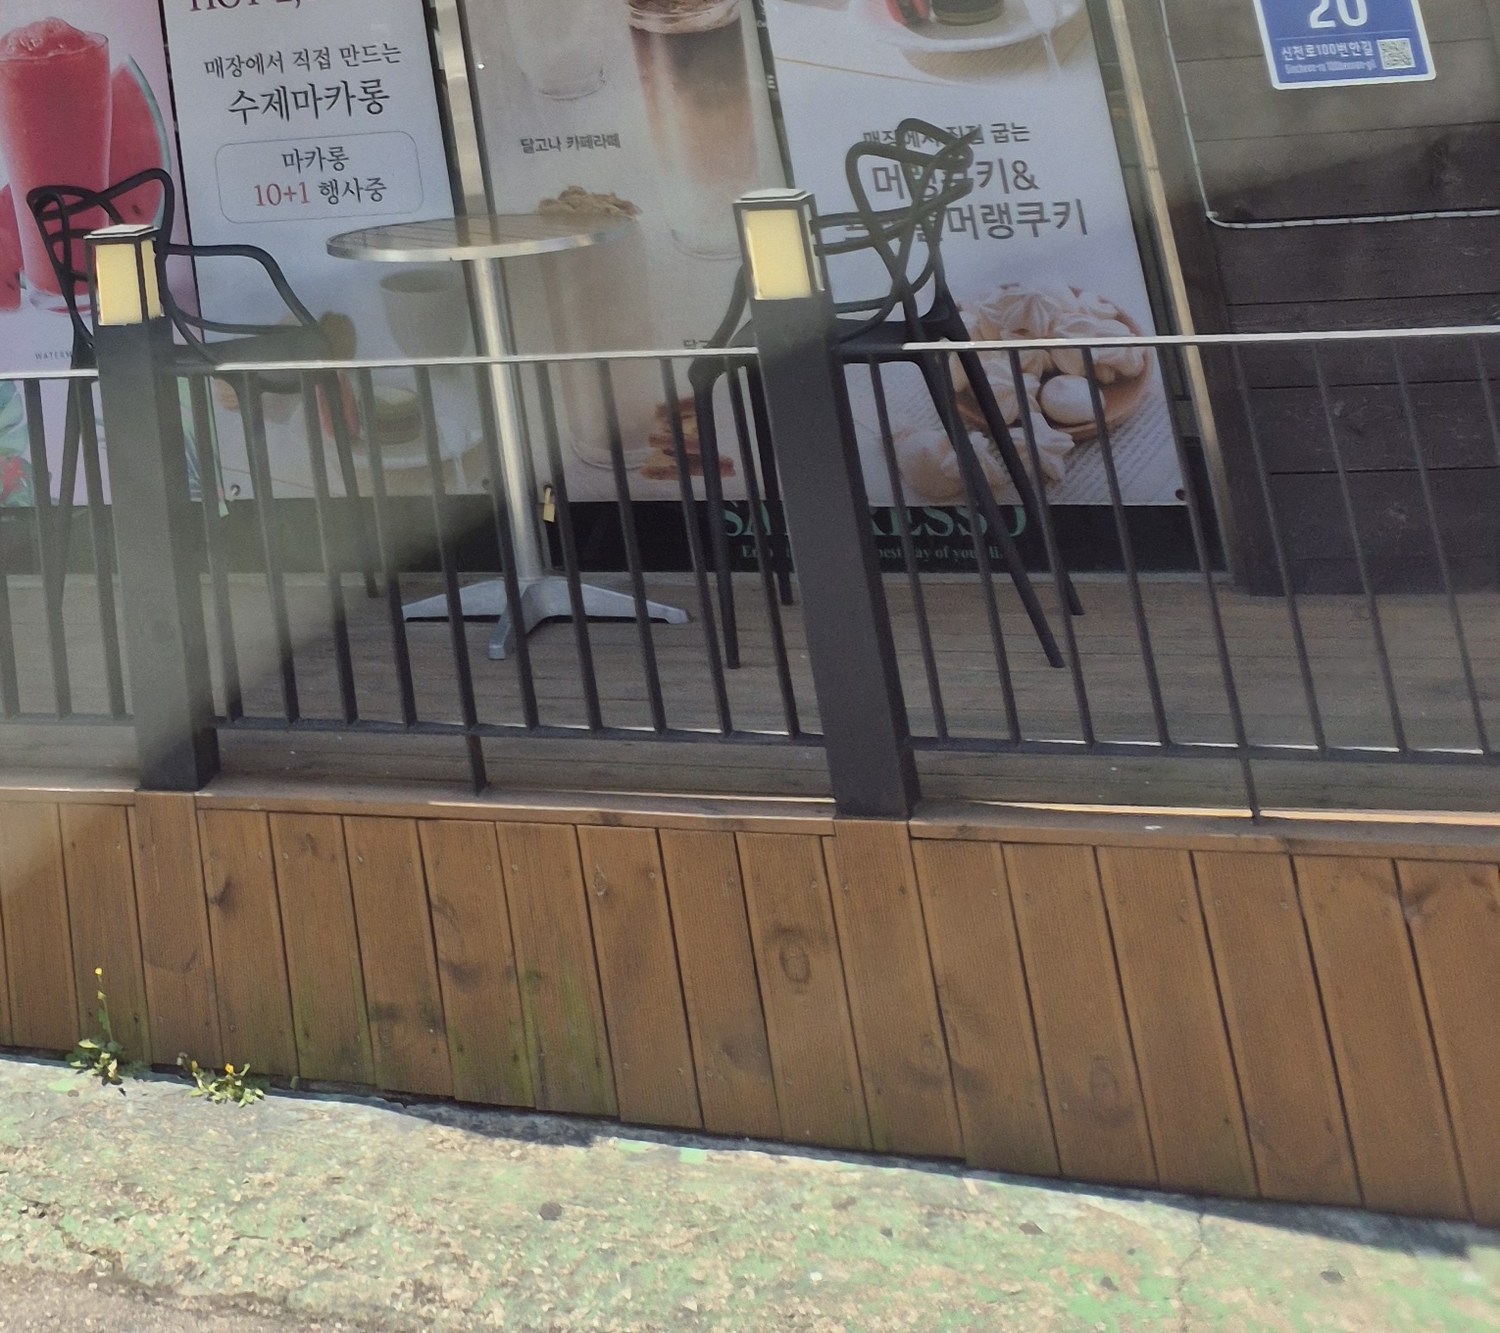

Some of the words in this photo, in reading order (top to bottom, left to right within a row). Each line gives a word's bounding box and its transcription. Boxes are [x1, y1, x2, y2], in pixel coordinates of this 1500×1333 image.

[204, 50, 284, 79] 매장에서
[292, 46, 334, 73] 직접
[338, 42, 403, 69] 만드는
[228, 78, 391, 126] 수제마카롱
[520, 136, 561, 154] 달고나
[991, 123, 1031, 144] 굽는
[281, 146, 349, 173] 마카롱
[253, 180, 310, 208] 10+1
[317, 176, 389, 206] 행사중
